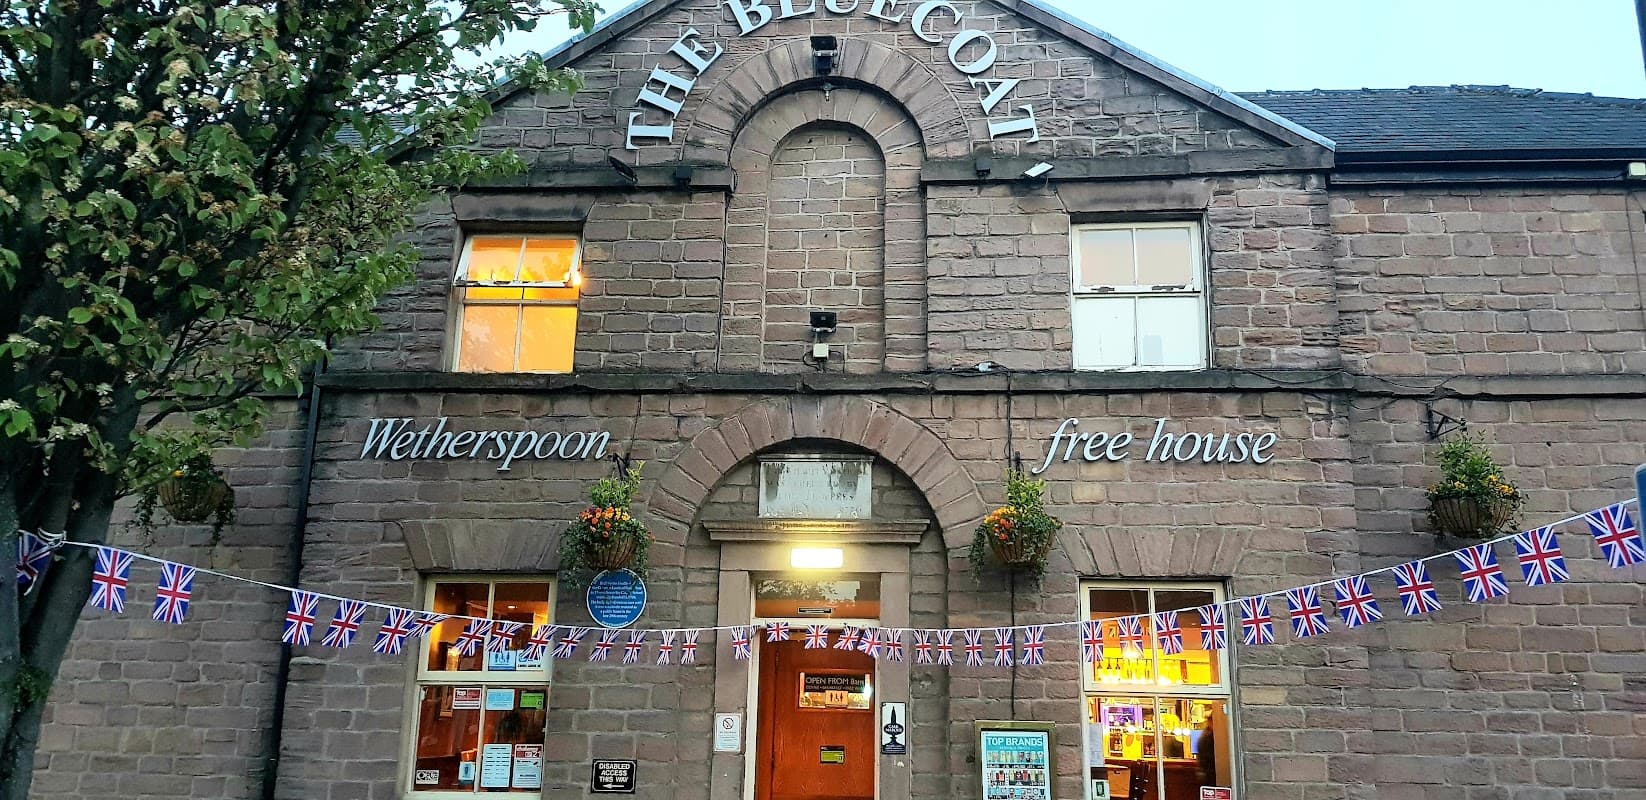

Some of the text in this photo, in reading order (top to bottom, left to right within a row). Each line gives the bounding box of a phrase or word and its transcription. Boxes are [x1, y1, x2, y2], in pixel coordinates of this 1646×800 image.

[625, 27, 724, 150] THE
[359, 416, 611, 472] Wetherspoon
[1032, 417, 1278, 475] free house
[987, 737, 1043, 746] TOP BRANDS
